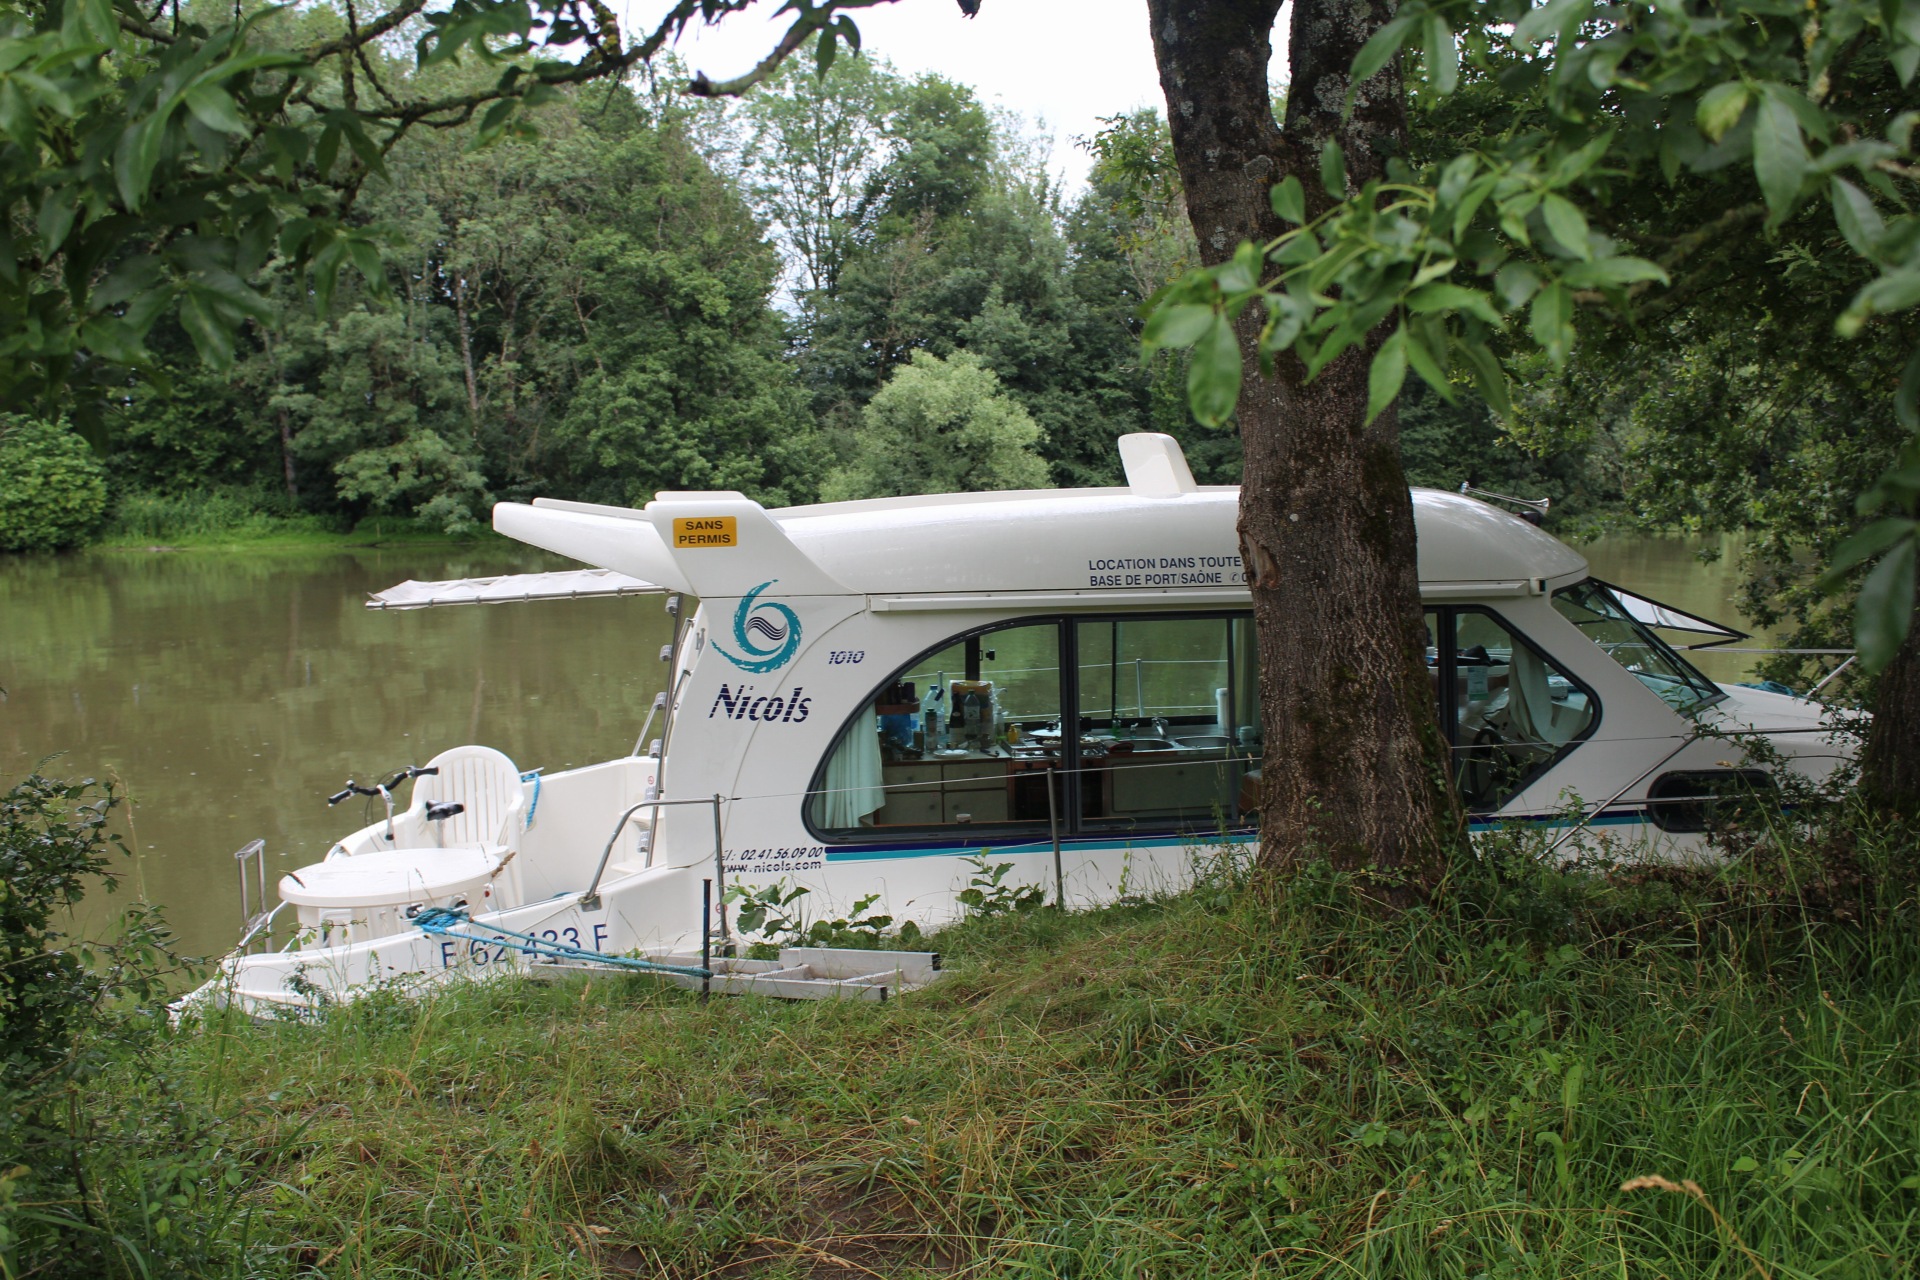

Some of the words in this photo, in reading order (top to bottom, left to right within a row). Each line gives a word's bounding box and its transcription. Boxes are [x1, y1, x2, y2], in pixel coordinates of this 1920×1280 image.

[685, 520, 724, 531] SANS
[678, 533, 731, 545] PERMIS
[1088, 558, 1156, 571] LOCATION
[1160, 557, 1196, 569] DANS
[1198, 556, 1242, 568] TOUTE
[1090, 573, 1122, 587] BASE
[1125, 573, 1142, 585] DE
[828, 650, 865, 665] 1010
[708, 683, 812, 723] Nicols
[593, 923, 608, 952] F
